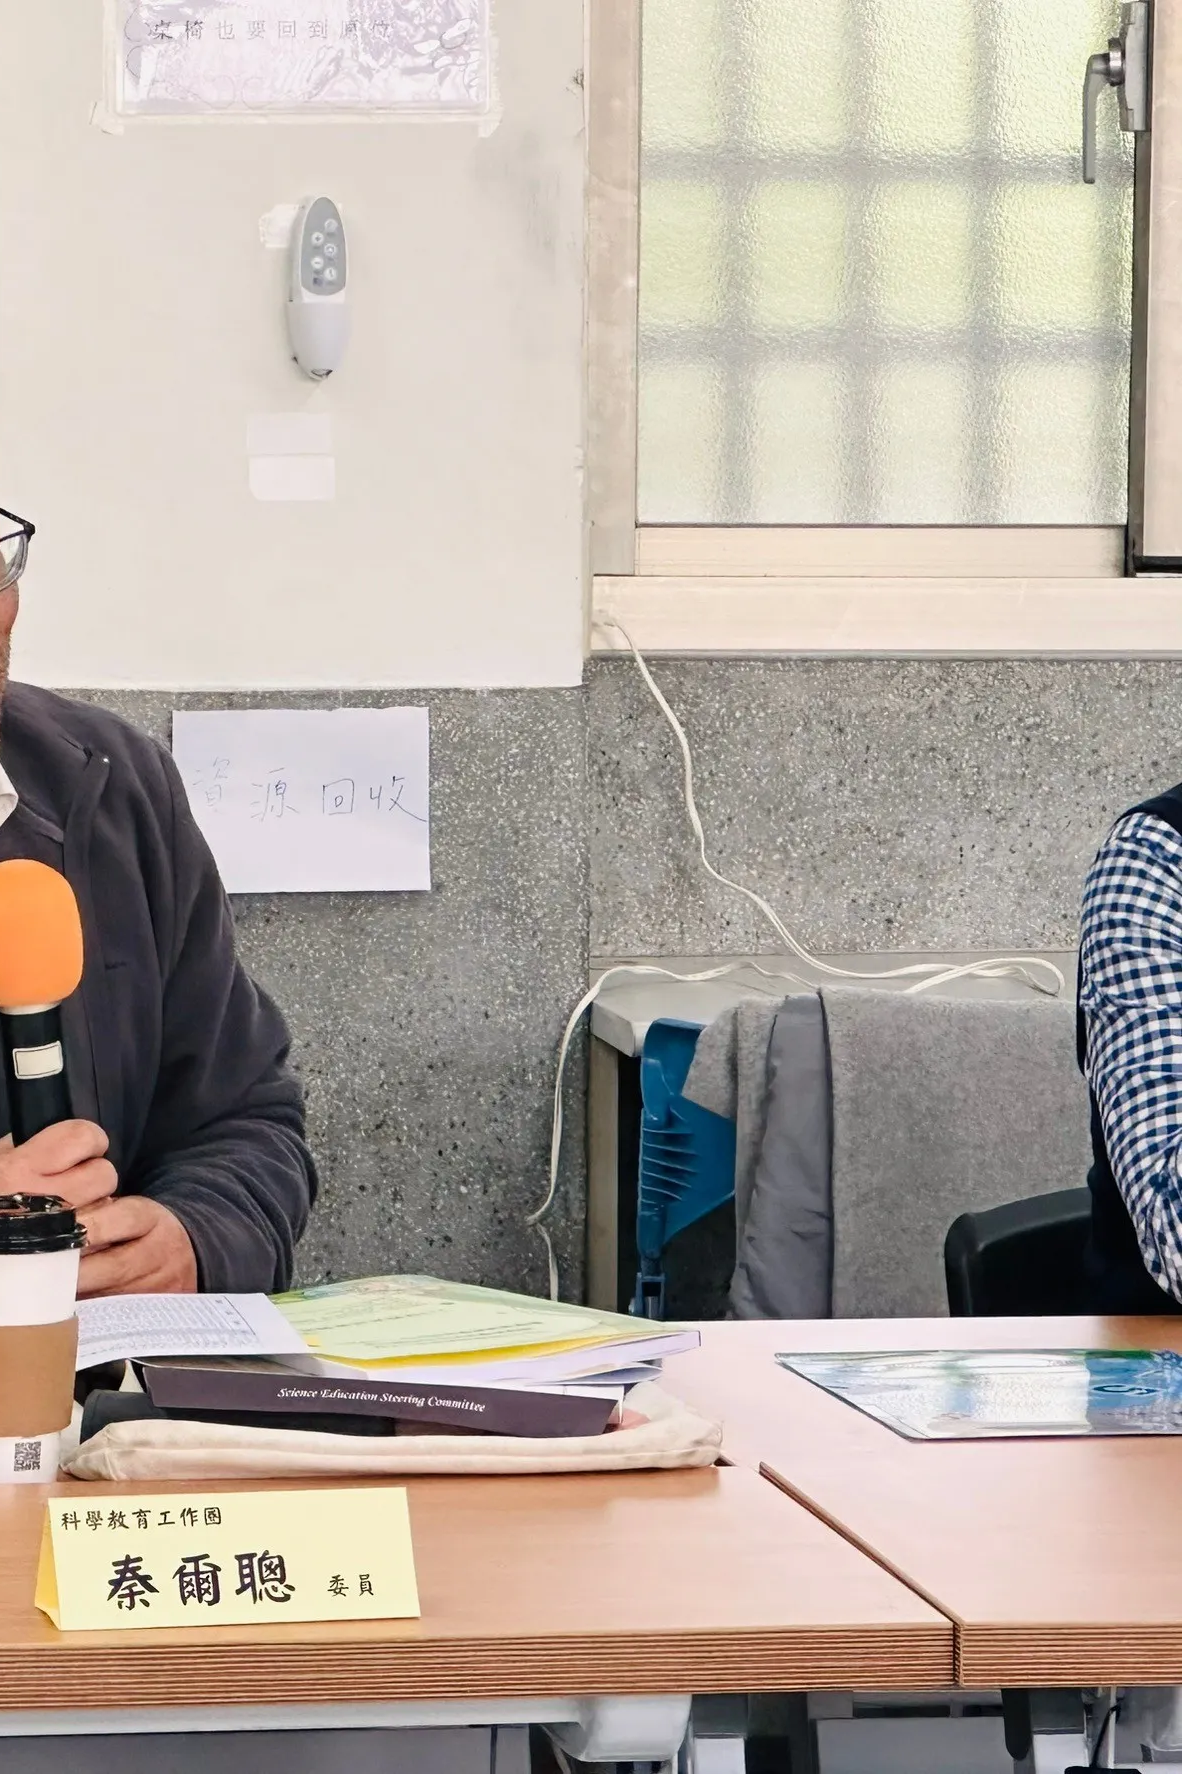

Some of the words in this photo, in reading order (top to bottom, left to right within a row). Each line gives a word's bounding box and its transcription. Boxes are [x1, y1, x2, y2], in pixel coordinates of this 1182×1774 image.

[192, 757, 427, 823] 資源回收
[277, 1387, 318, 1399] Science
[321, 1388, 378, 1401] Education
[379, 1392, 426, 1407] Steering
[427, 1396, 486, 1413] Committee
[107, 1550, 296, 1611] 秦爾聰
[327, 1574, 375, 1597] 委員
